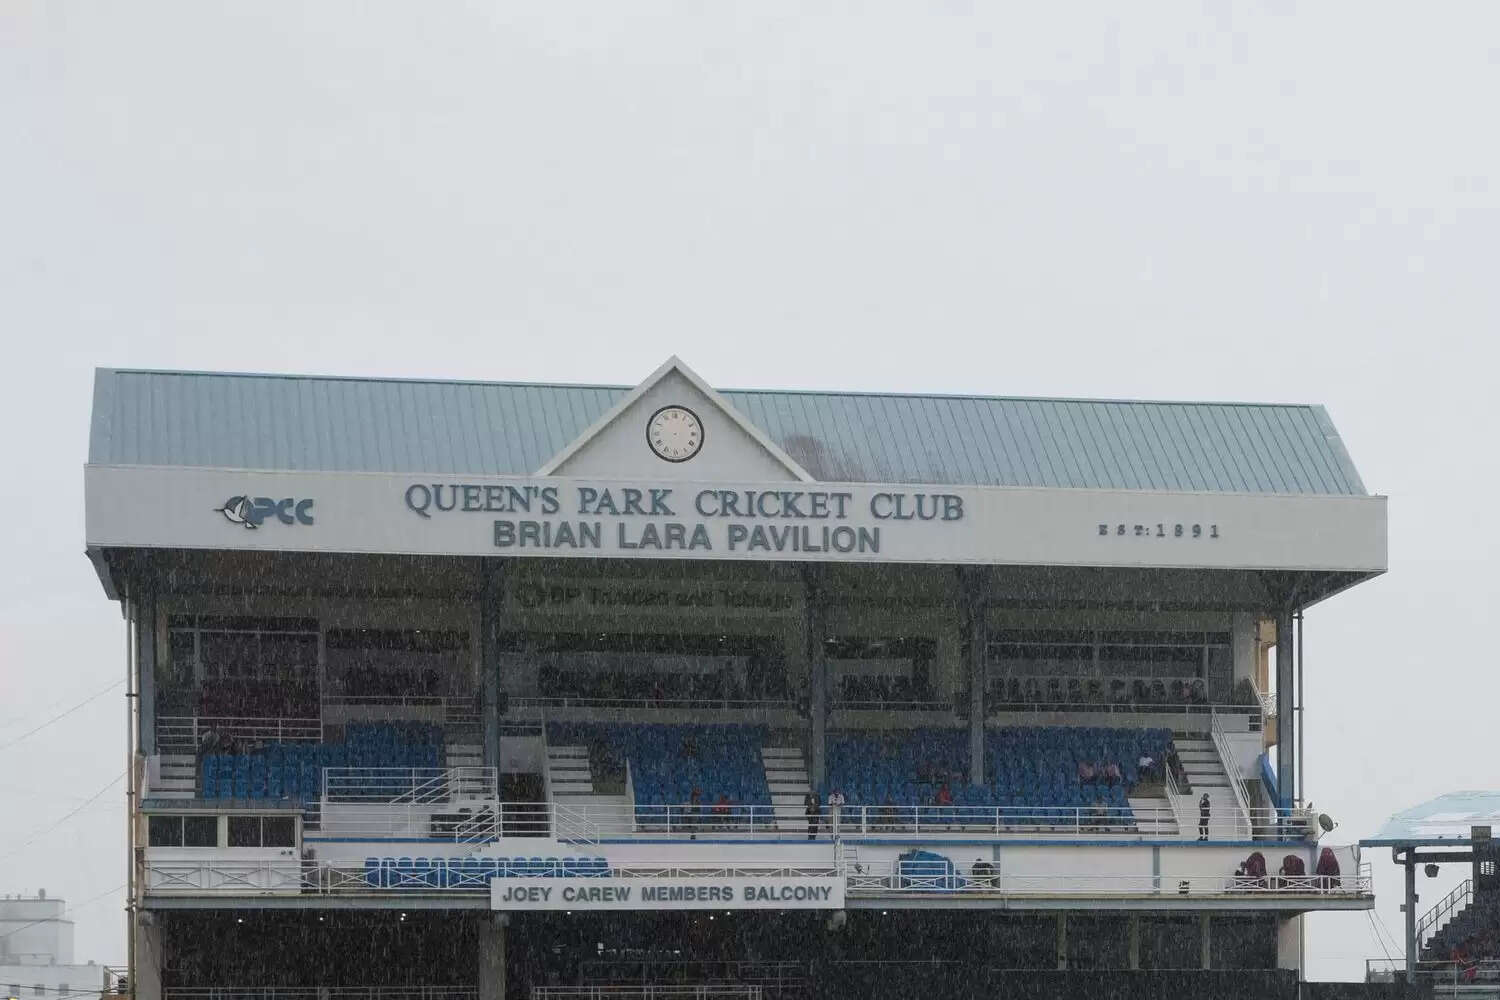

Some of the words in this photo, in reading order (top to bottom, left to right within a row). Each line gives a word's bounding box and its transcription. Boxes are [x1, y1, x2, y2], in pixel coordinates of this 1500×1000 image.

[404, 483, 560, 519] QUEEN'S
[576, 487, 676, 516] PARK
[694, 489, 853, 519] CRICKET
[869, 492, 965, 521] CLUB
[493, 519, 602, 549] BRIAN
[618, 521, 713, 551] LARA
[727, 523, 881, 553] PAVILION
[502, 886, 552, 902] JOEY
[562, 886, 632, 902] CAREW
[641, 886, 734, 902] MEMBERS
[744, 886, 833, 902] BALCONY
